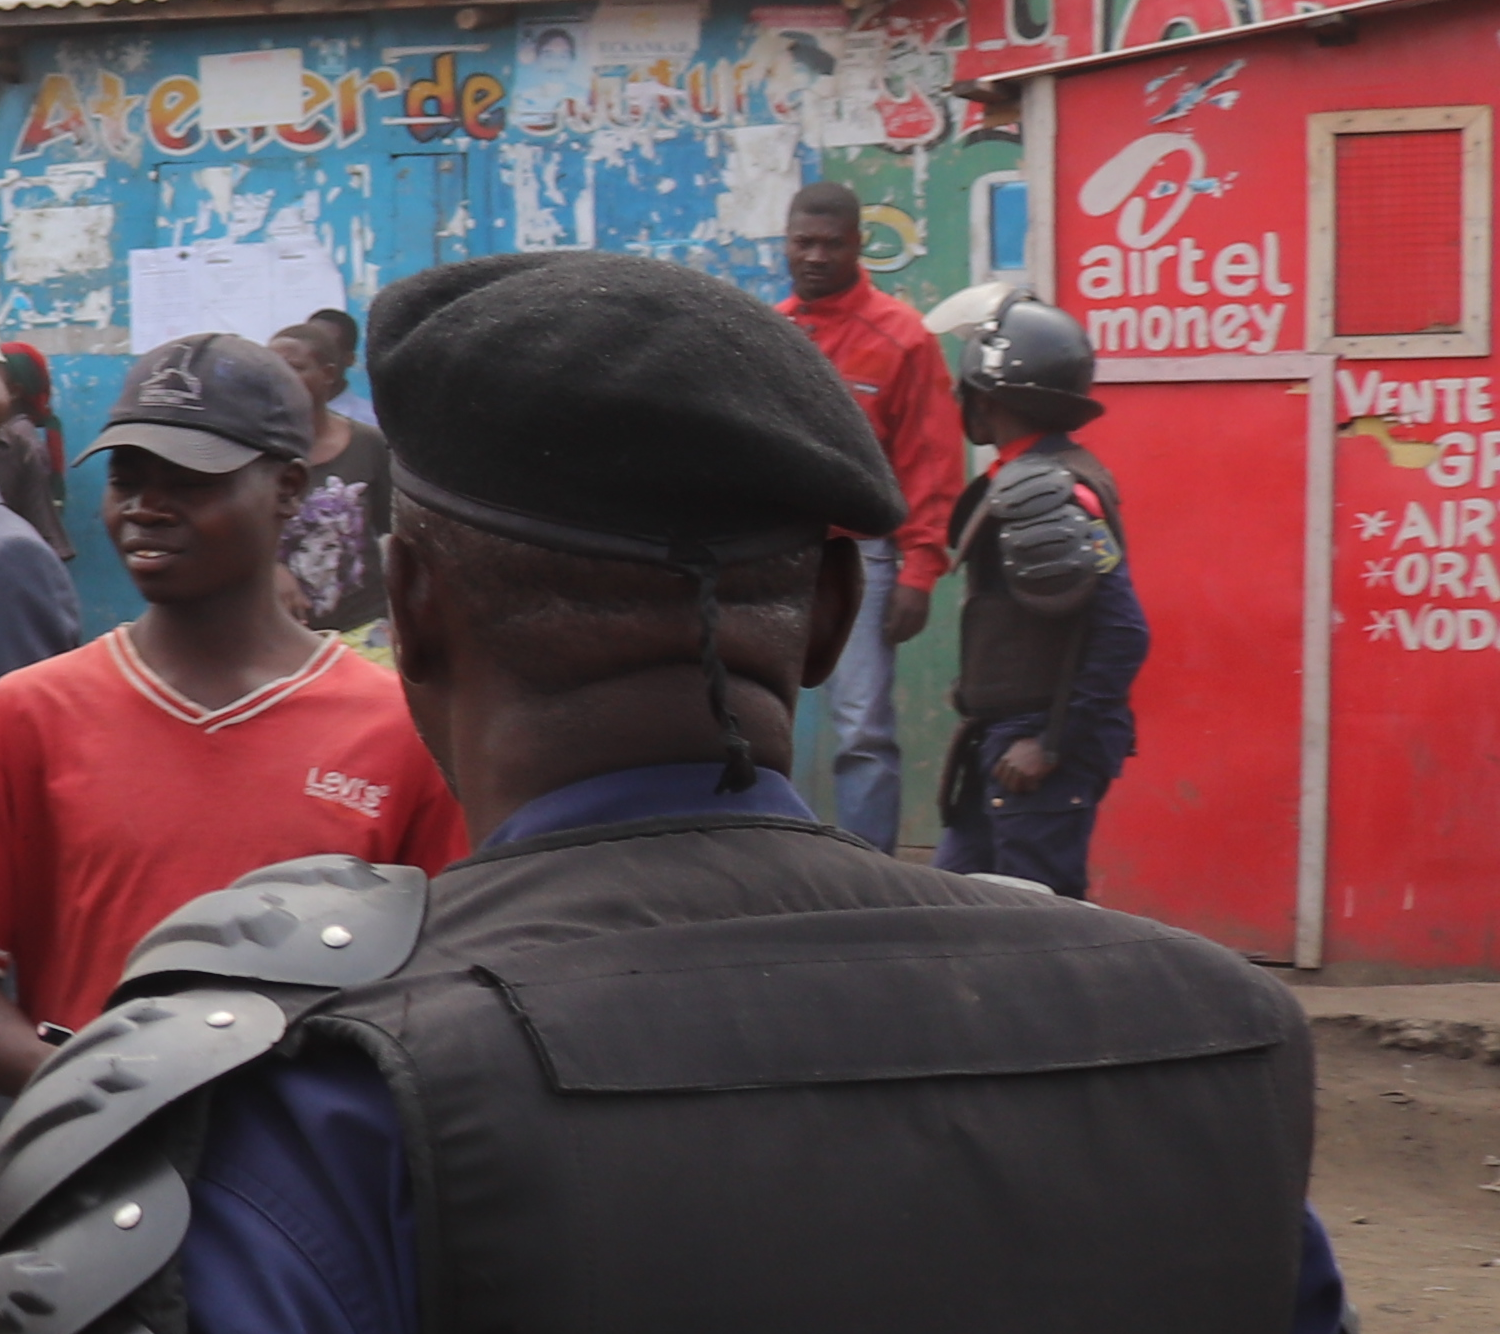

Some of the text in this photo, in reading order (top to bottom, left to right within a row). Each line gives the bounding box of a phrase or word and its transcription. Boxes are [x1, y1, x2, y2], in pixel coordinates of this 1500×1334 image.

[10, 67, 399, 163] Ateer
[404, 51, 507, 143] de
[1077, 231, 1293, 299] airtel
[1086, 302, 1286, 353] money
[1336, 369, 1494, 427] VENTE
